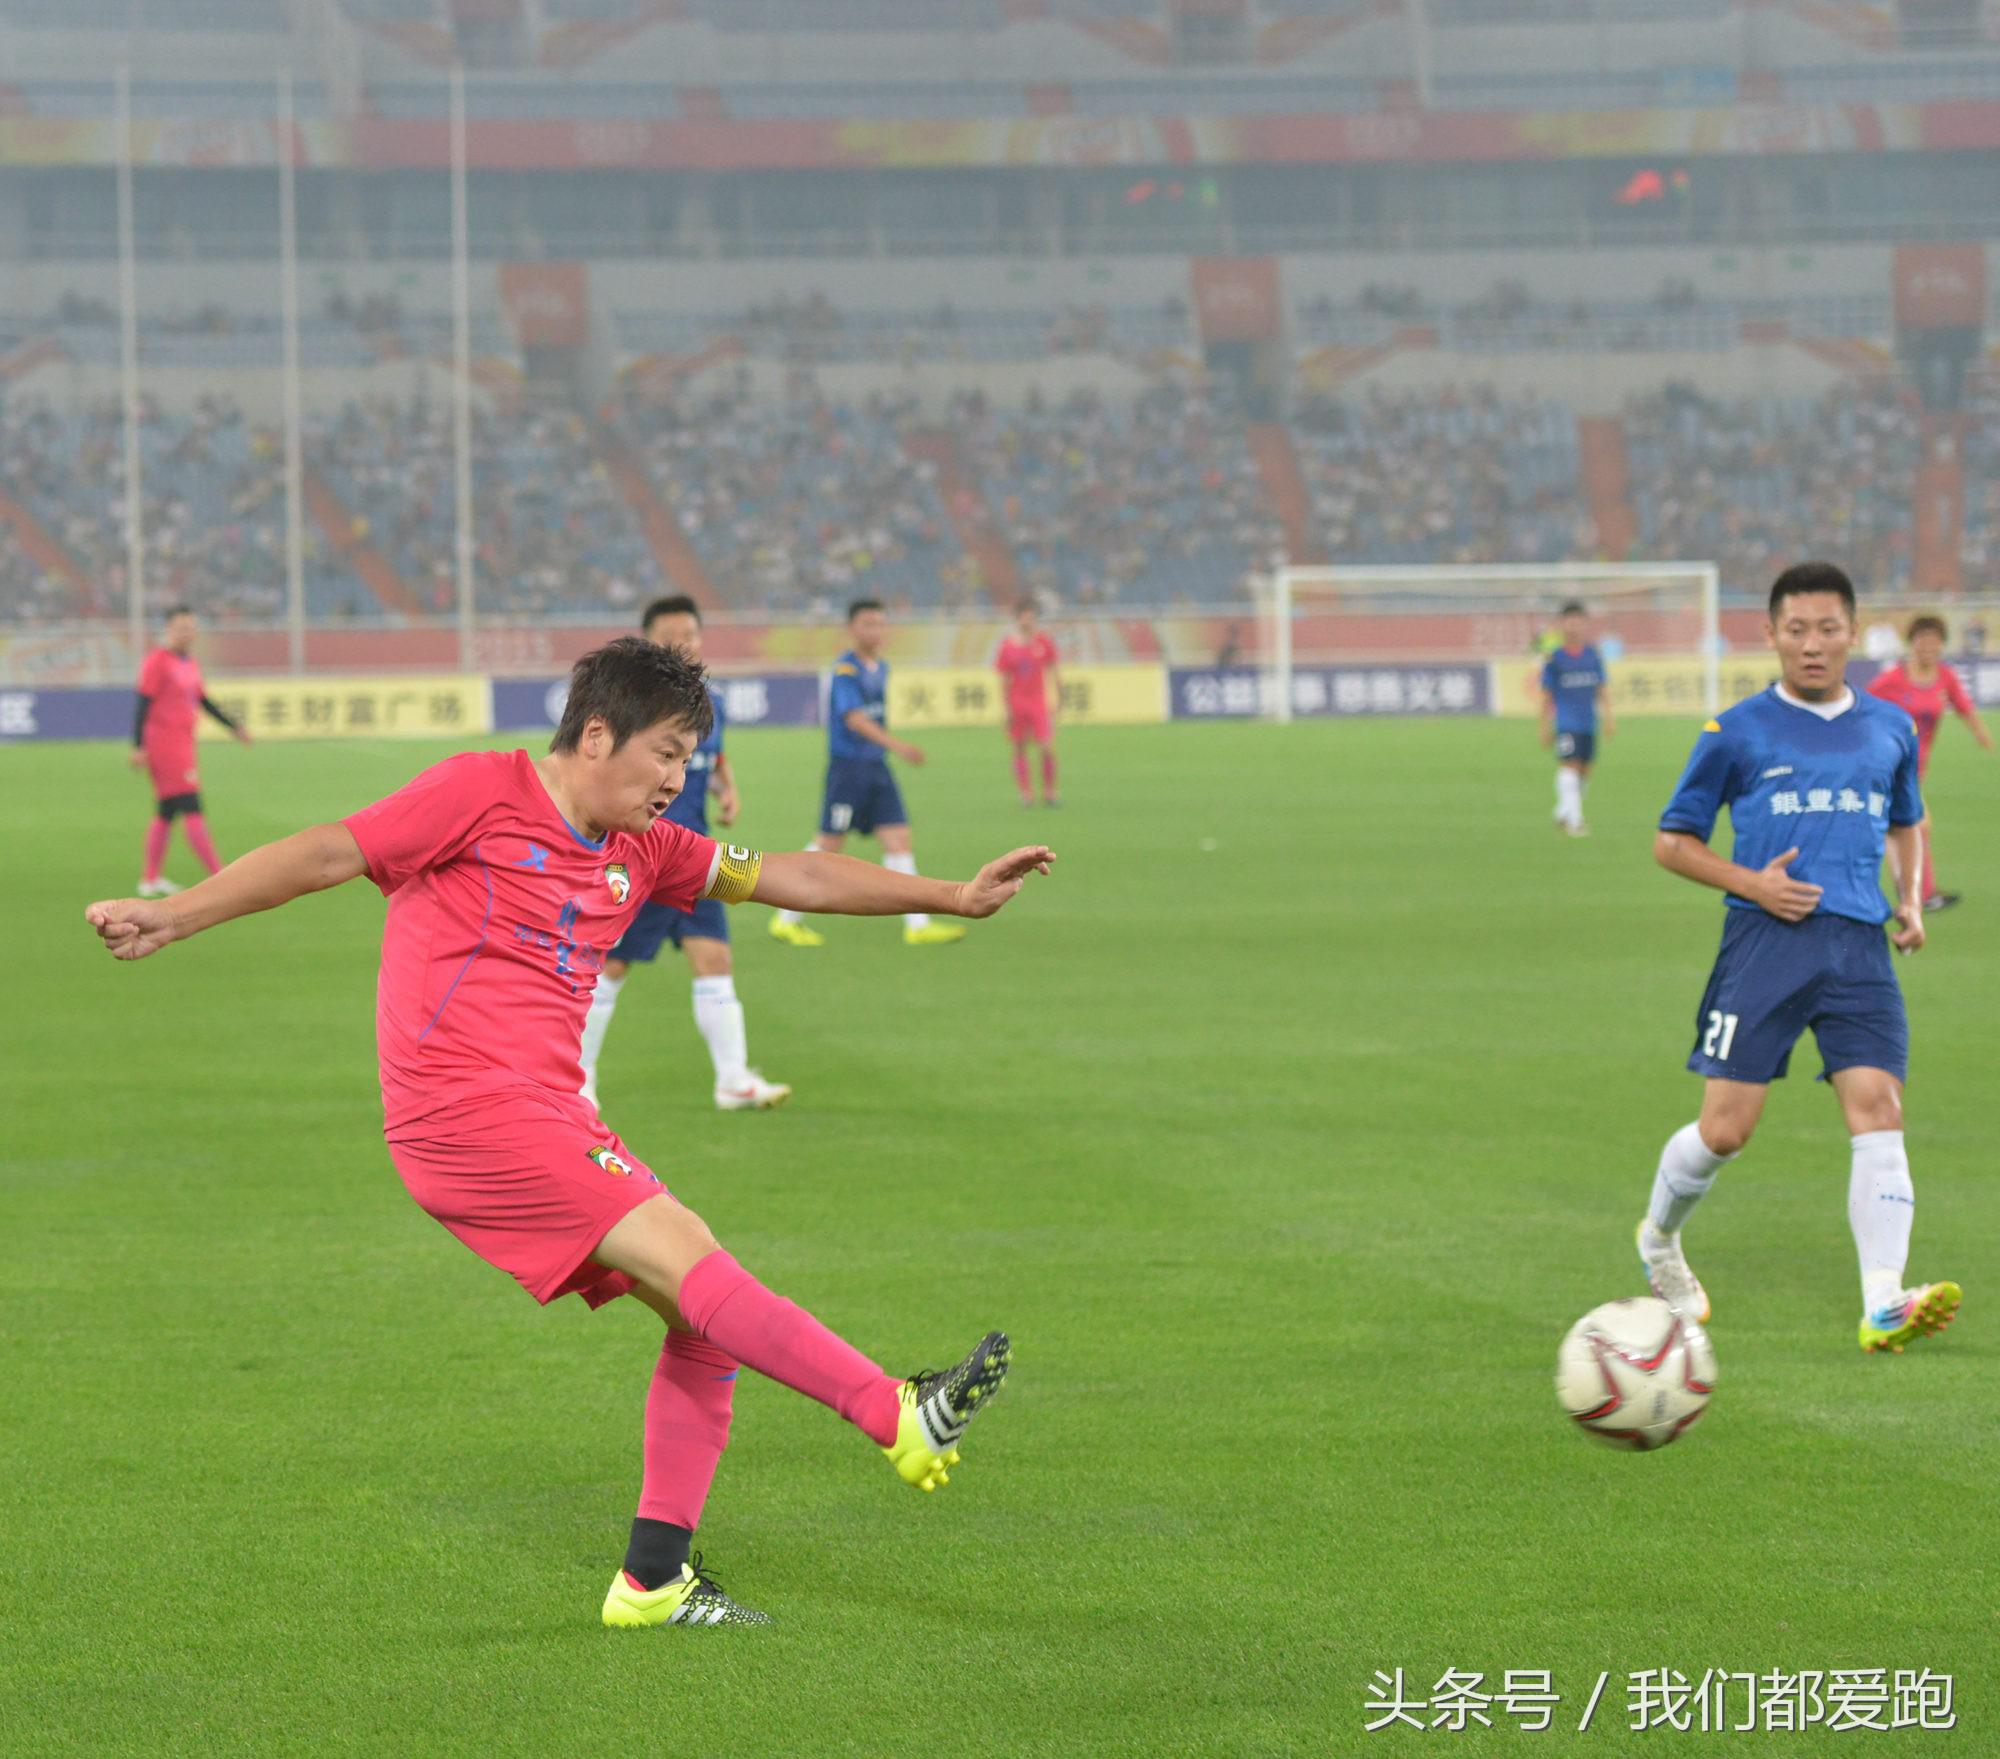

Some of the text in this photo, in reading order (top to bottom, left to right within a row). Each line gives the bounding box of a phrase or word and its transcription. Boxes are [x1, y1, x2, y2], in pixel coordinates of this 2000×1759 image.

[898, 680, 1093, 714] 火种程
[1703, 1009, 1739, 1061] 21
